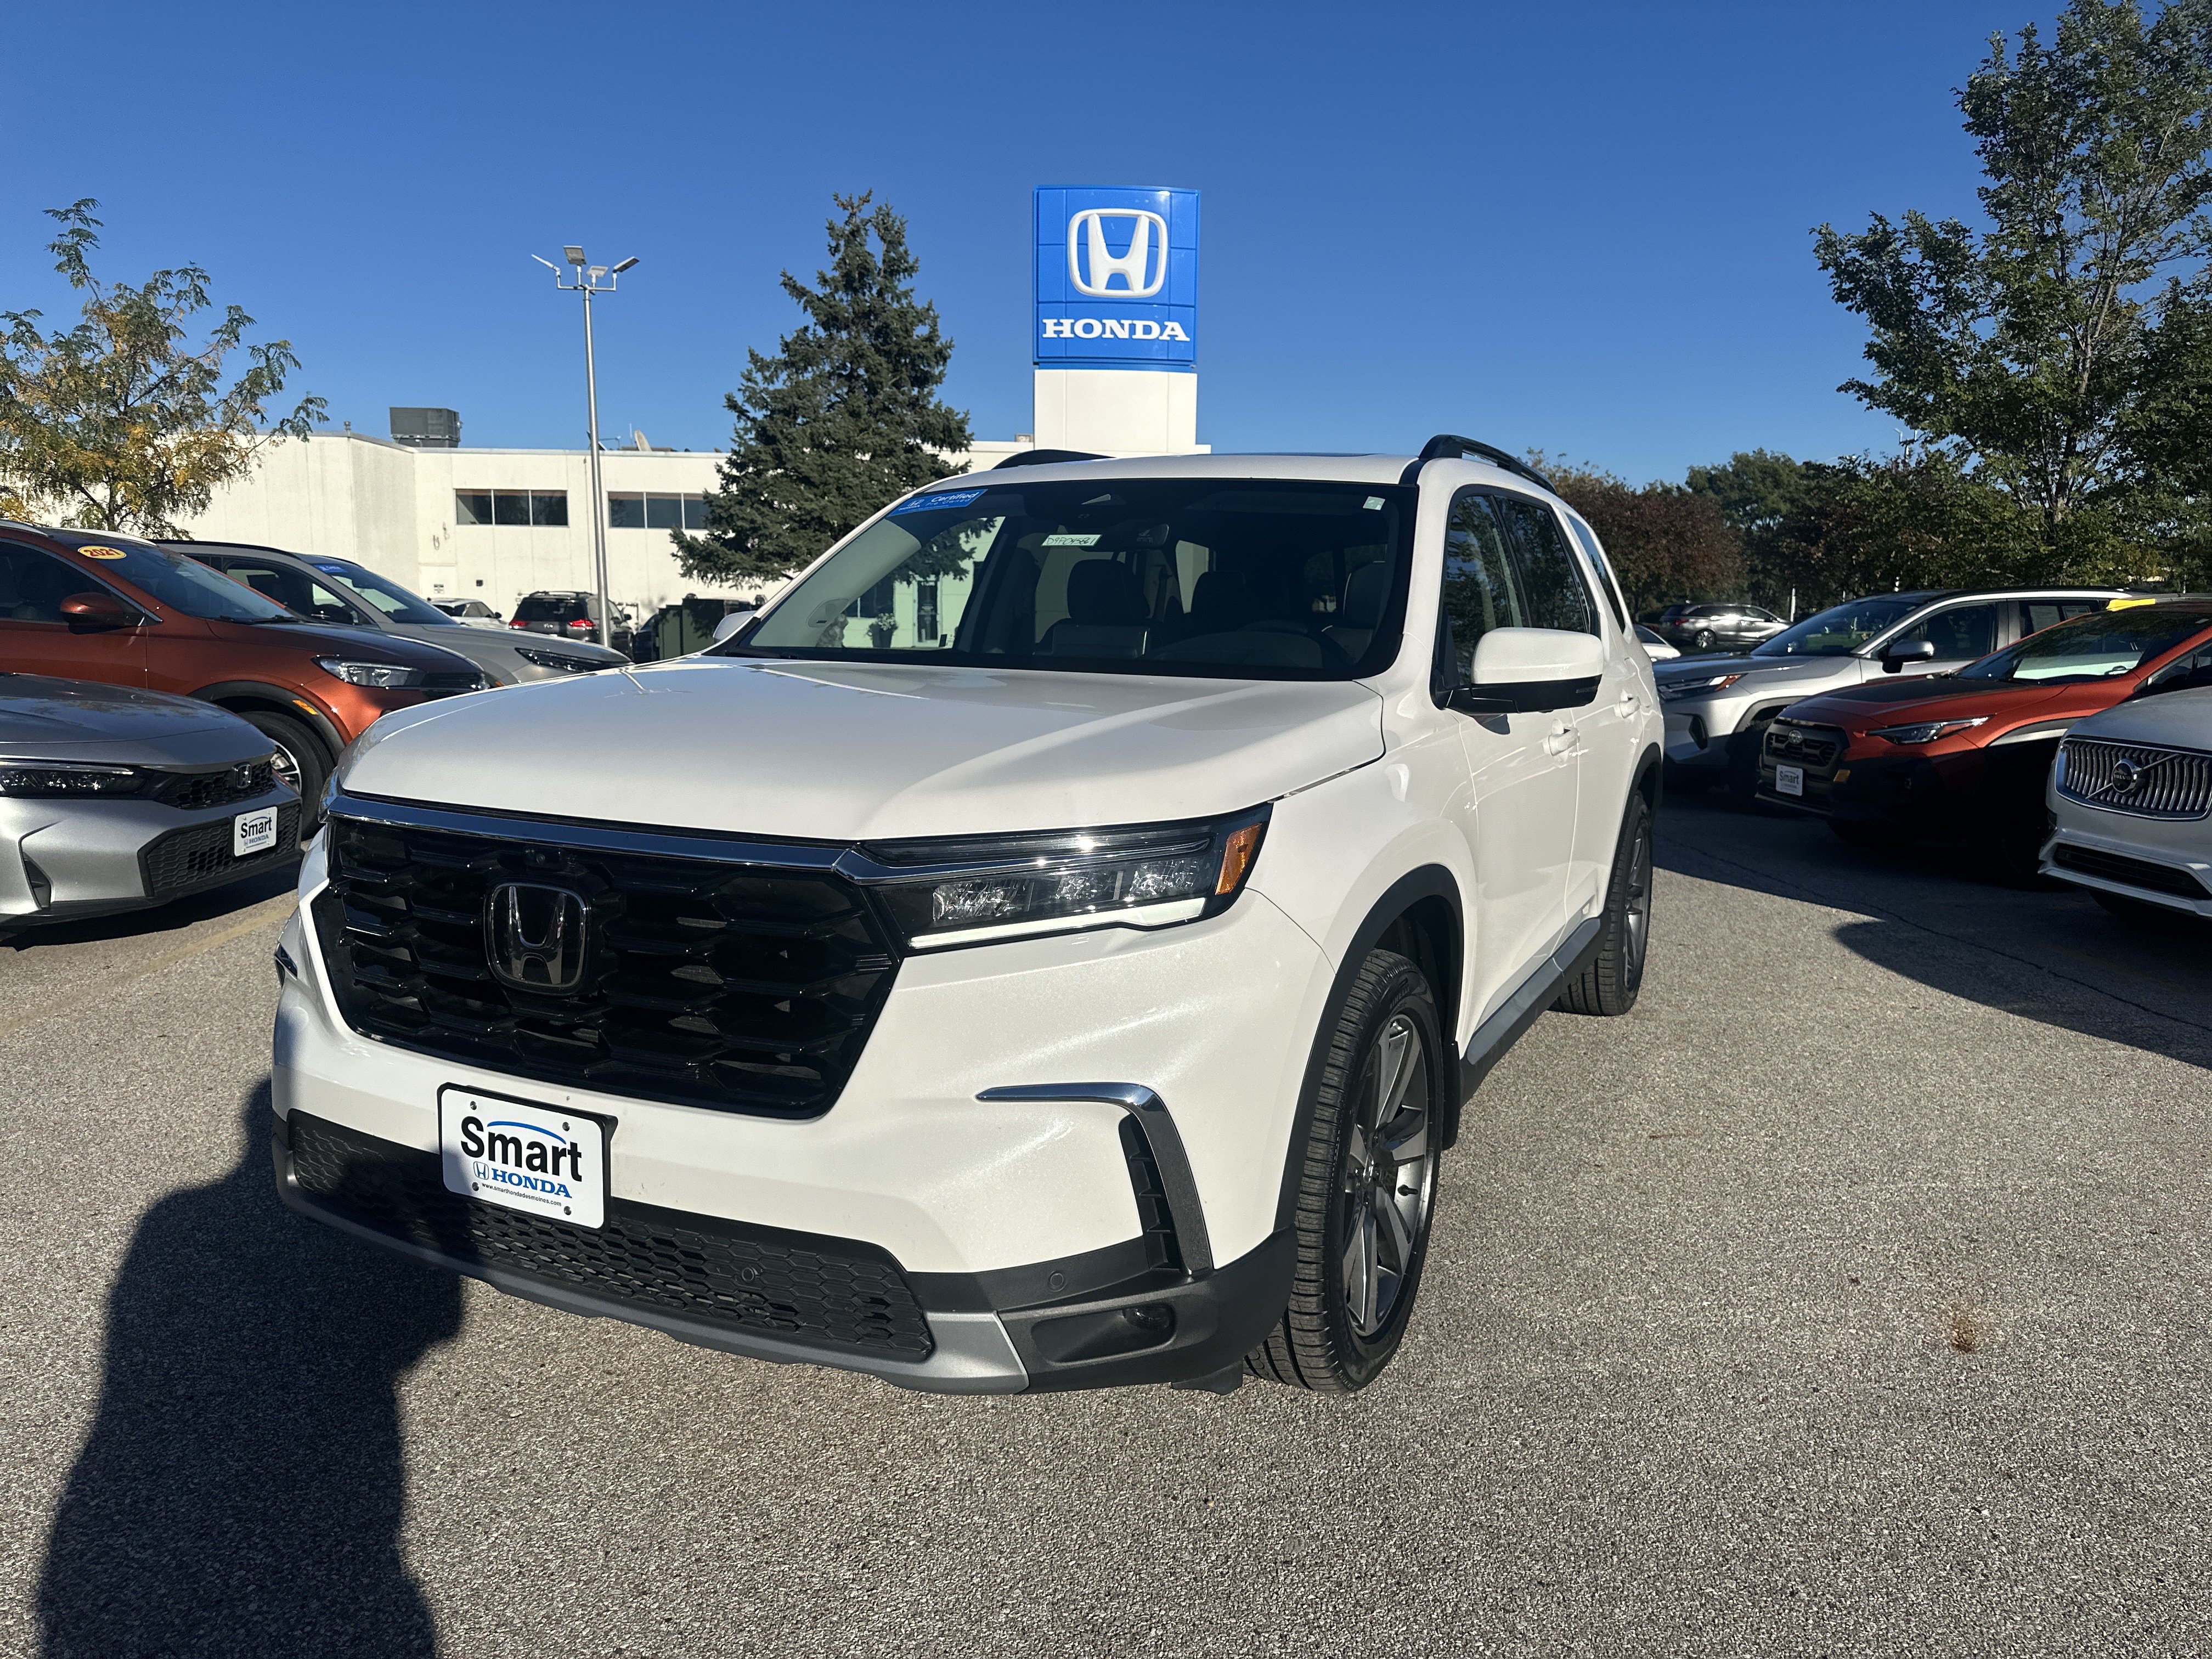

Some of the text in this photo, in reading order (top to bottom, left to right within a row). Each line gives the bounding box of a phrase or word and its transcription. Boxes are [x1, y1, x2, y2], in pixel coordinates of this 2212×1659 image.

[1042, 318, 1190, 341] HONDA
[931, 492, 979, 503] Certified
[84, 549, 121, 557] 2021
[1779, 770, 1799, 785] Smart
[240, 816, 272, 839] Smart
[249, 834, 269, 844] HONDA
[460, 1115, 583, 1182] Smart
[481, 1182, 562, 1207] www.smarthondadesmoines.com
[492, 1167, 573, 1199] HONDA
